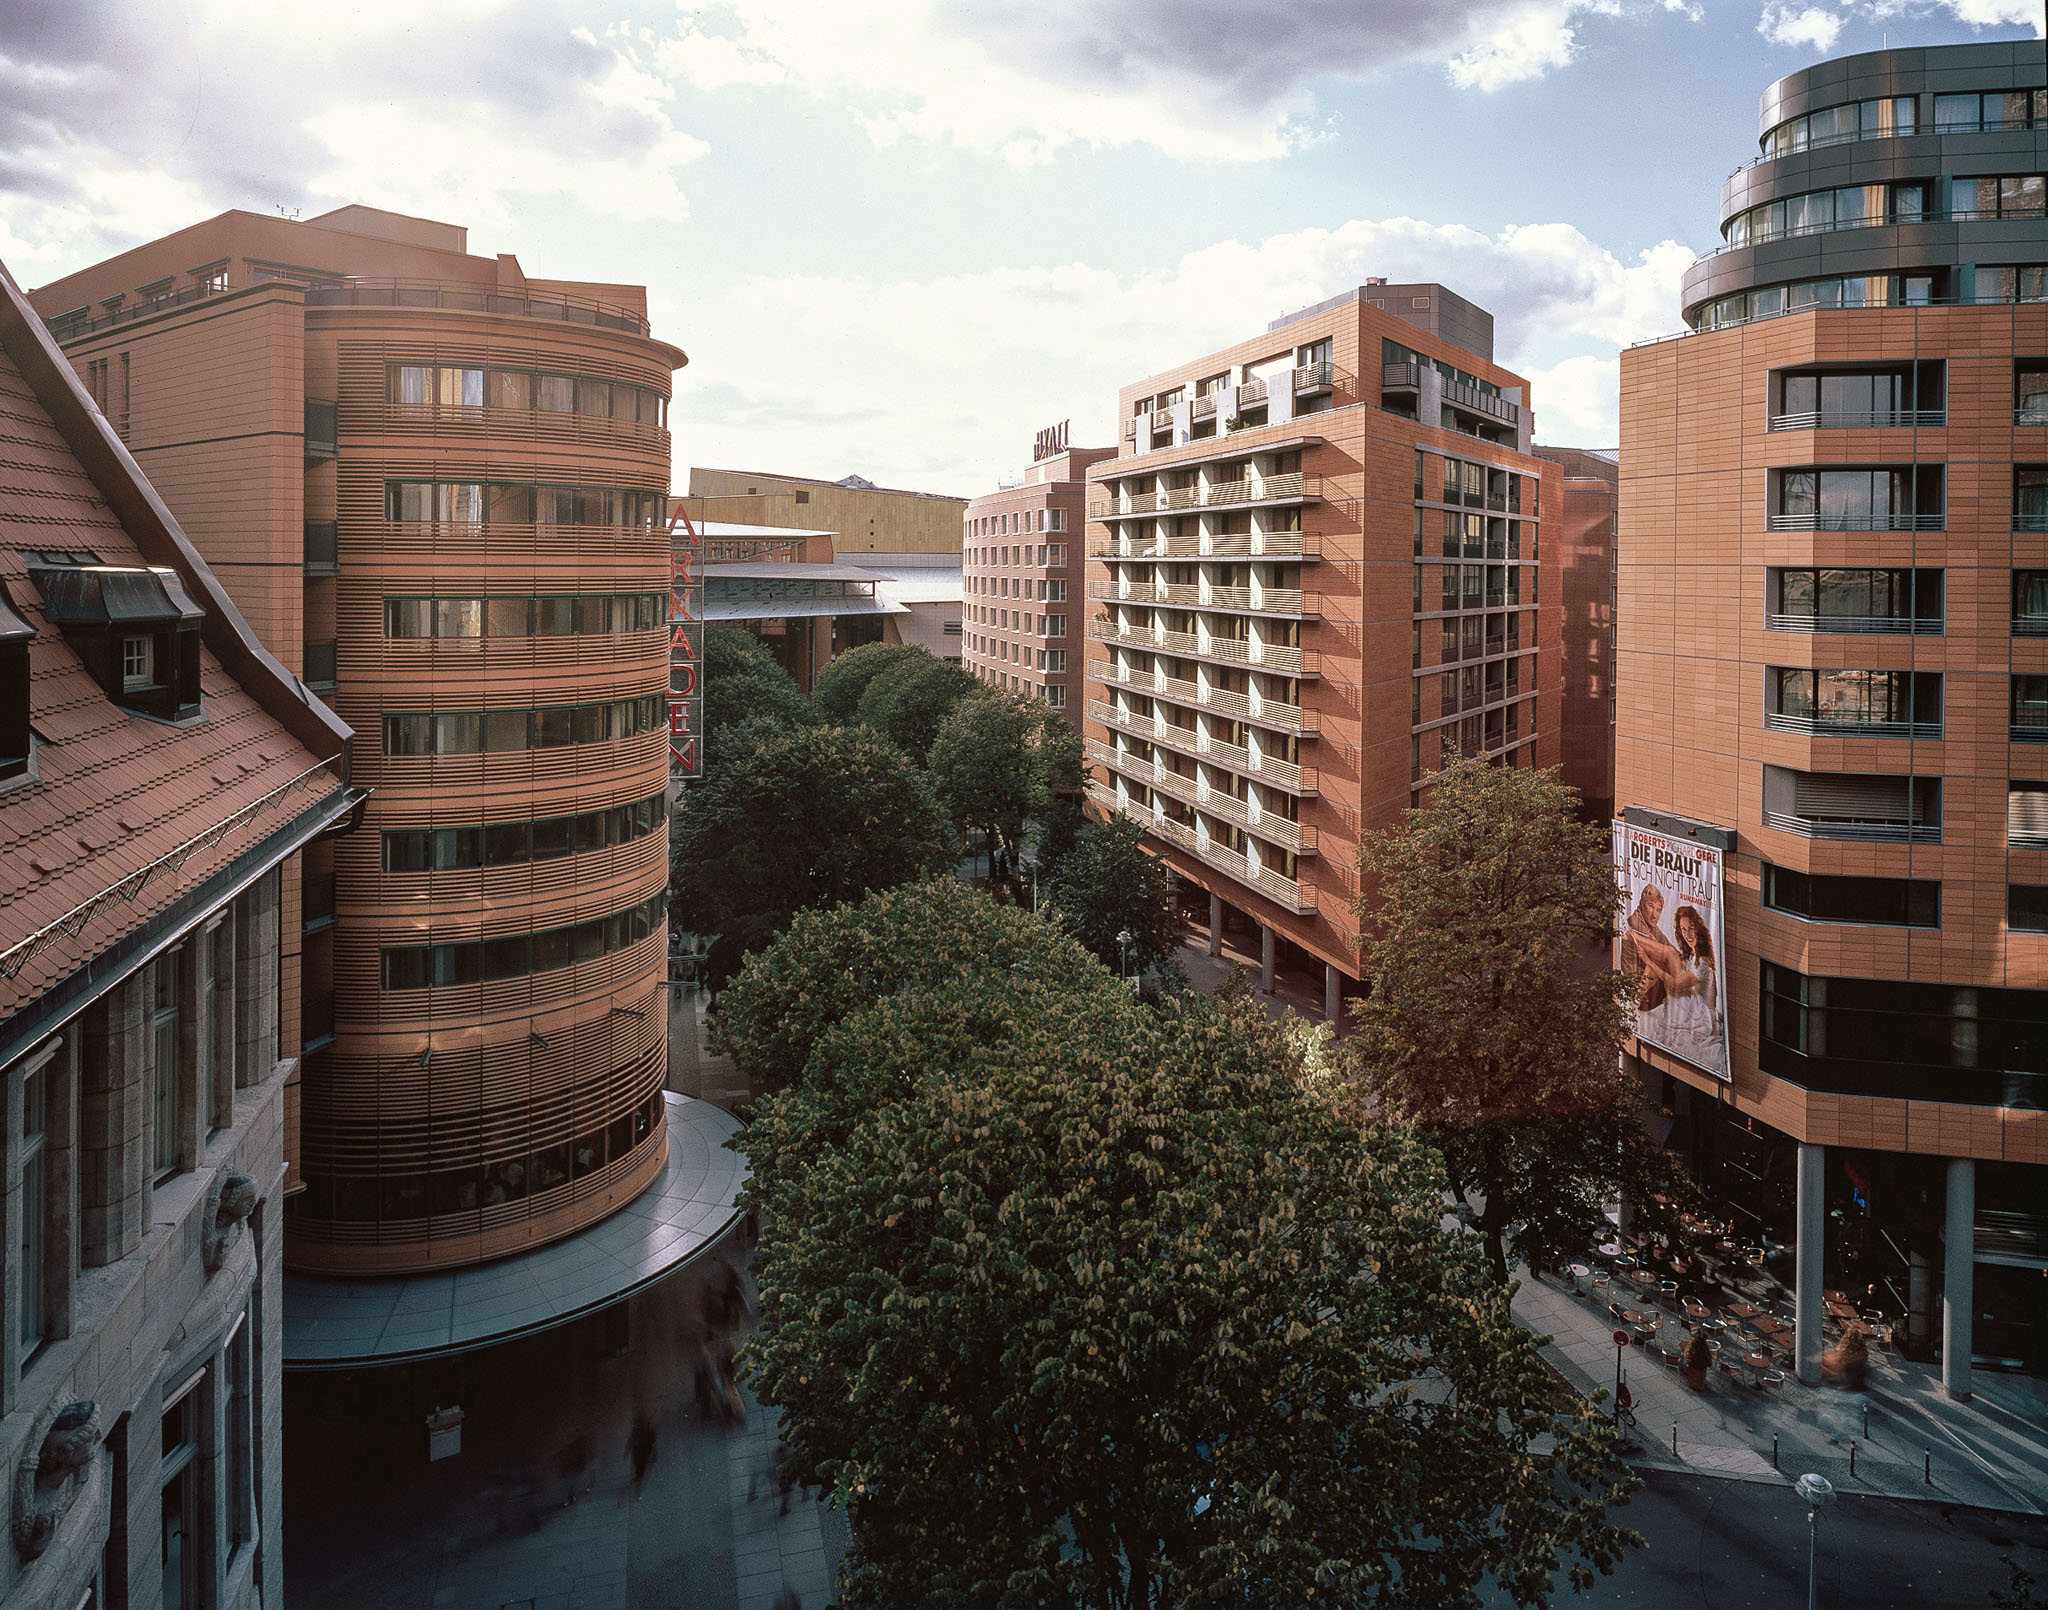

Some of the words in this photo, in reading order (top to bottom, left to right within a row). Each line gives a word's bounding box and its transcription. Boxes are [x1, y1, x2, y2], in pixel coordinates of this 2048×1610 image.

[665, 503, 701, 772] ARKADEN
[1631, 841, 1651, 863] DIE
[1655, 848, 1702, 878] BRAUT
[1633, 832, 1666, 849] ROBERTS
[1695, 849, 1717, 864] GERE
[1633, 860, 1653, 883] SICH
[1655, 867, 1684, 893] NICHT
[1687, 876, 1717, 903] TRAUT
